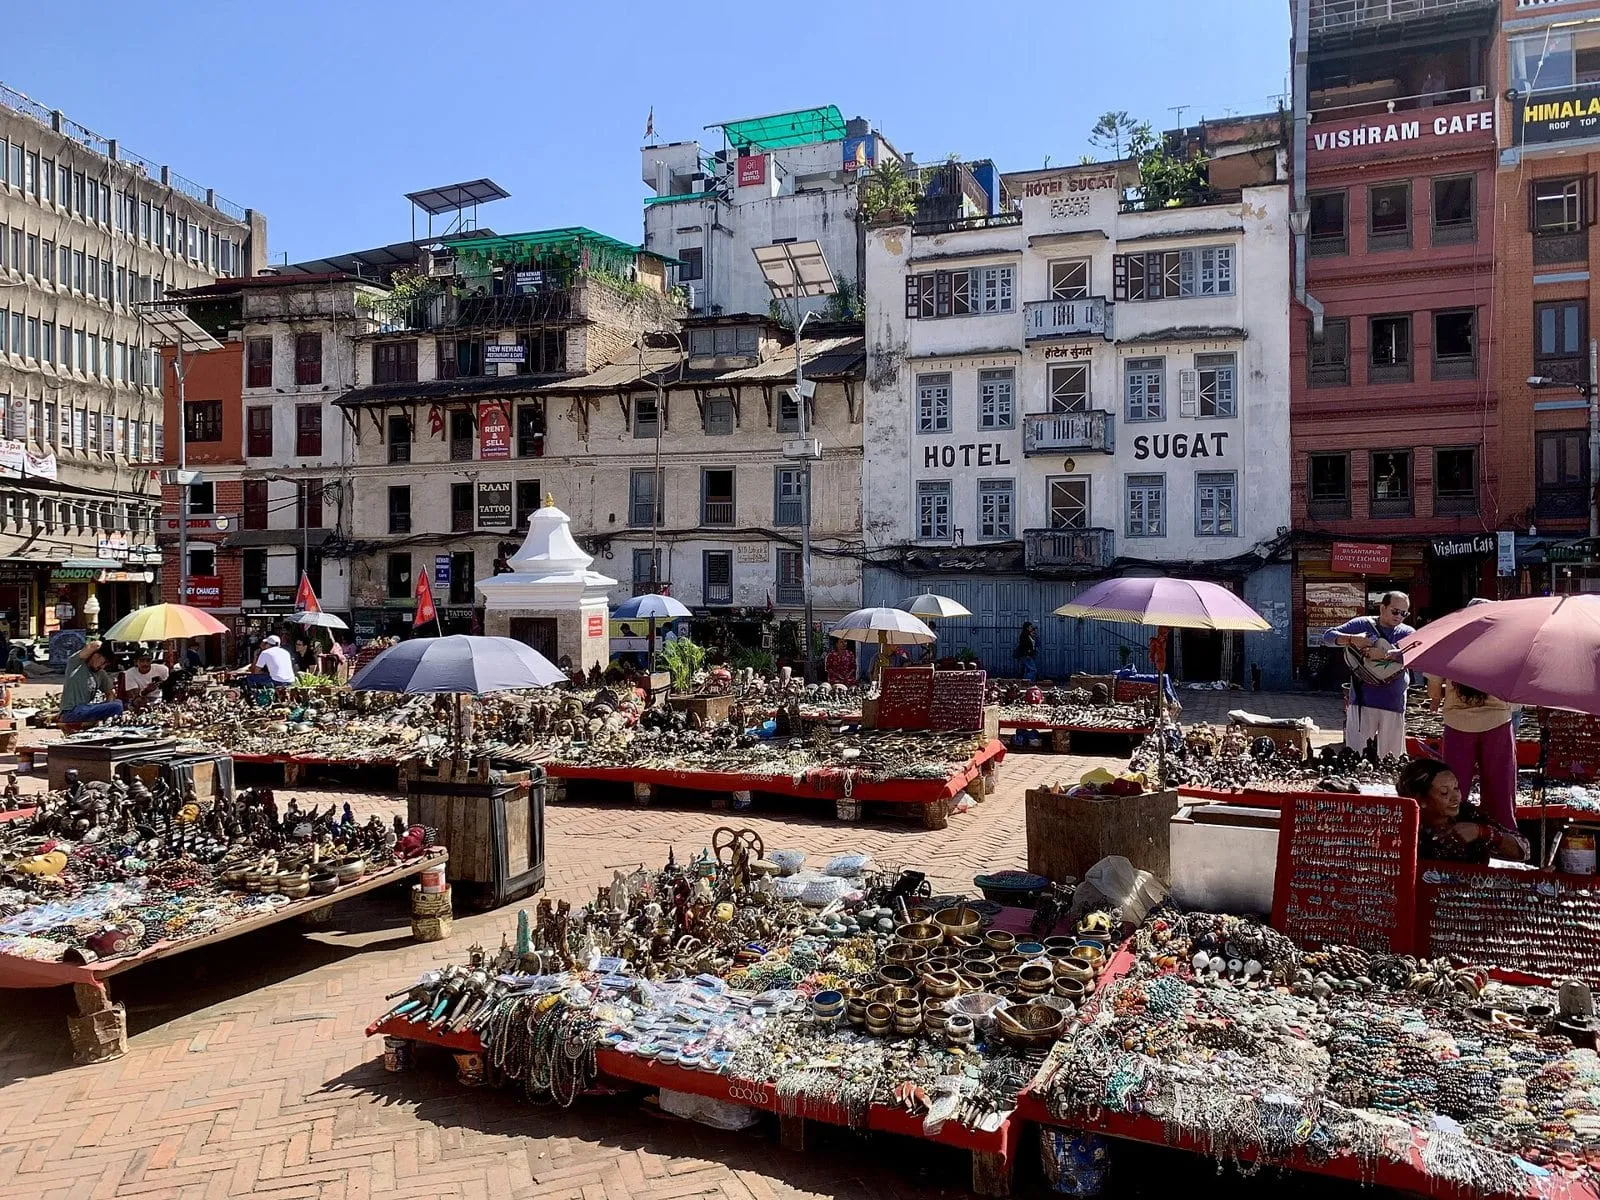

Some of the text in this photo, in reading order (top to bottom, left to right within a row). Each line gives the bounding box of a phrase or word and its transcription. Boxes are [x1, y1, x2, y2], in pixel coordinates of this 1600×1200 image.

[1525, 97, 1600, 123] HIMALA
[1549, 117, 1597, 131] ROOF TOP
[1314, 111, 1493, 151] VISHRAM CAFE
[487, 345, 524, 353] NEW NEWARI
[484, 425, 505, 434] RENT
[5, 441, 21, 451] Spa
[924, 432, 1229, 468] HOTEL SUGAT
[479, 483, 510, 492] RAAN
[479, 505, 511, 513] TATTOO
[1433, 536, 1495, 557] Vishram Café
[196, 587, 220, 595] CHANGER
